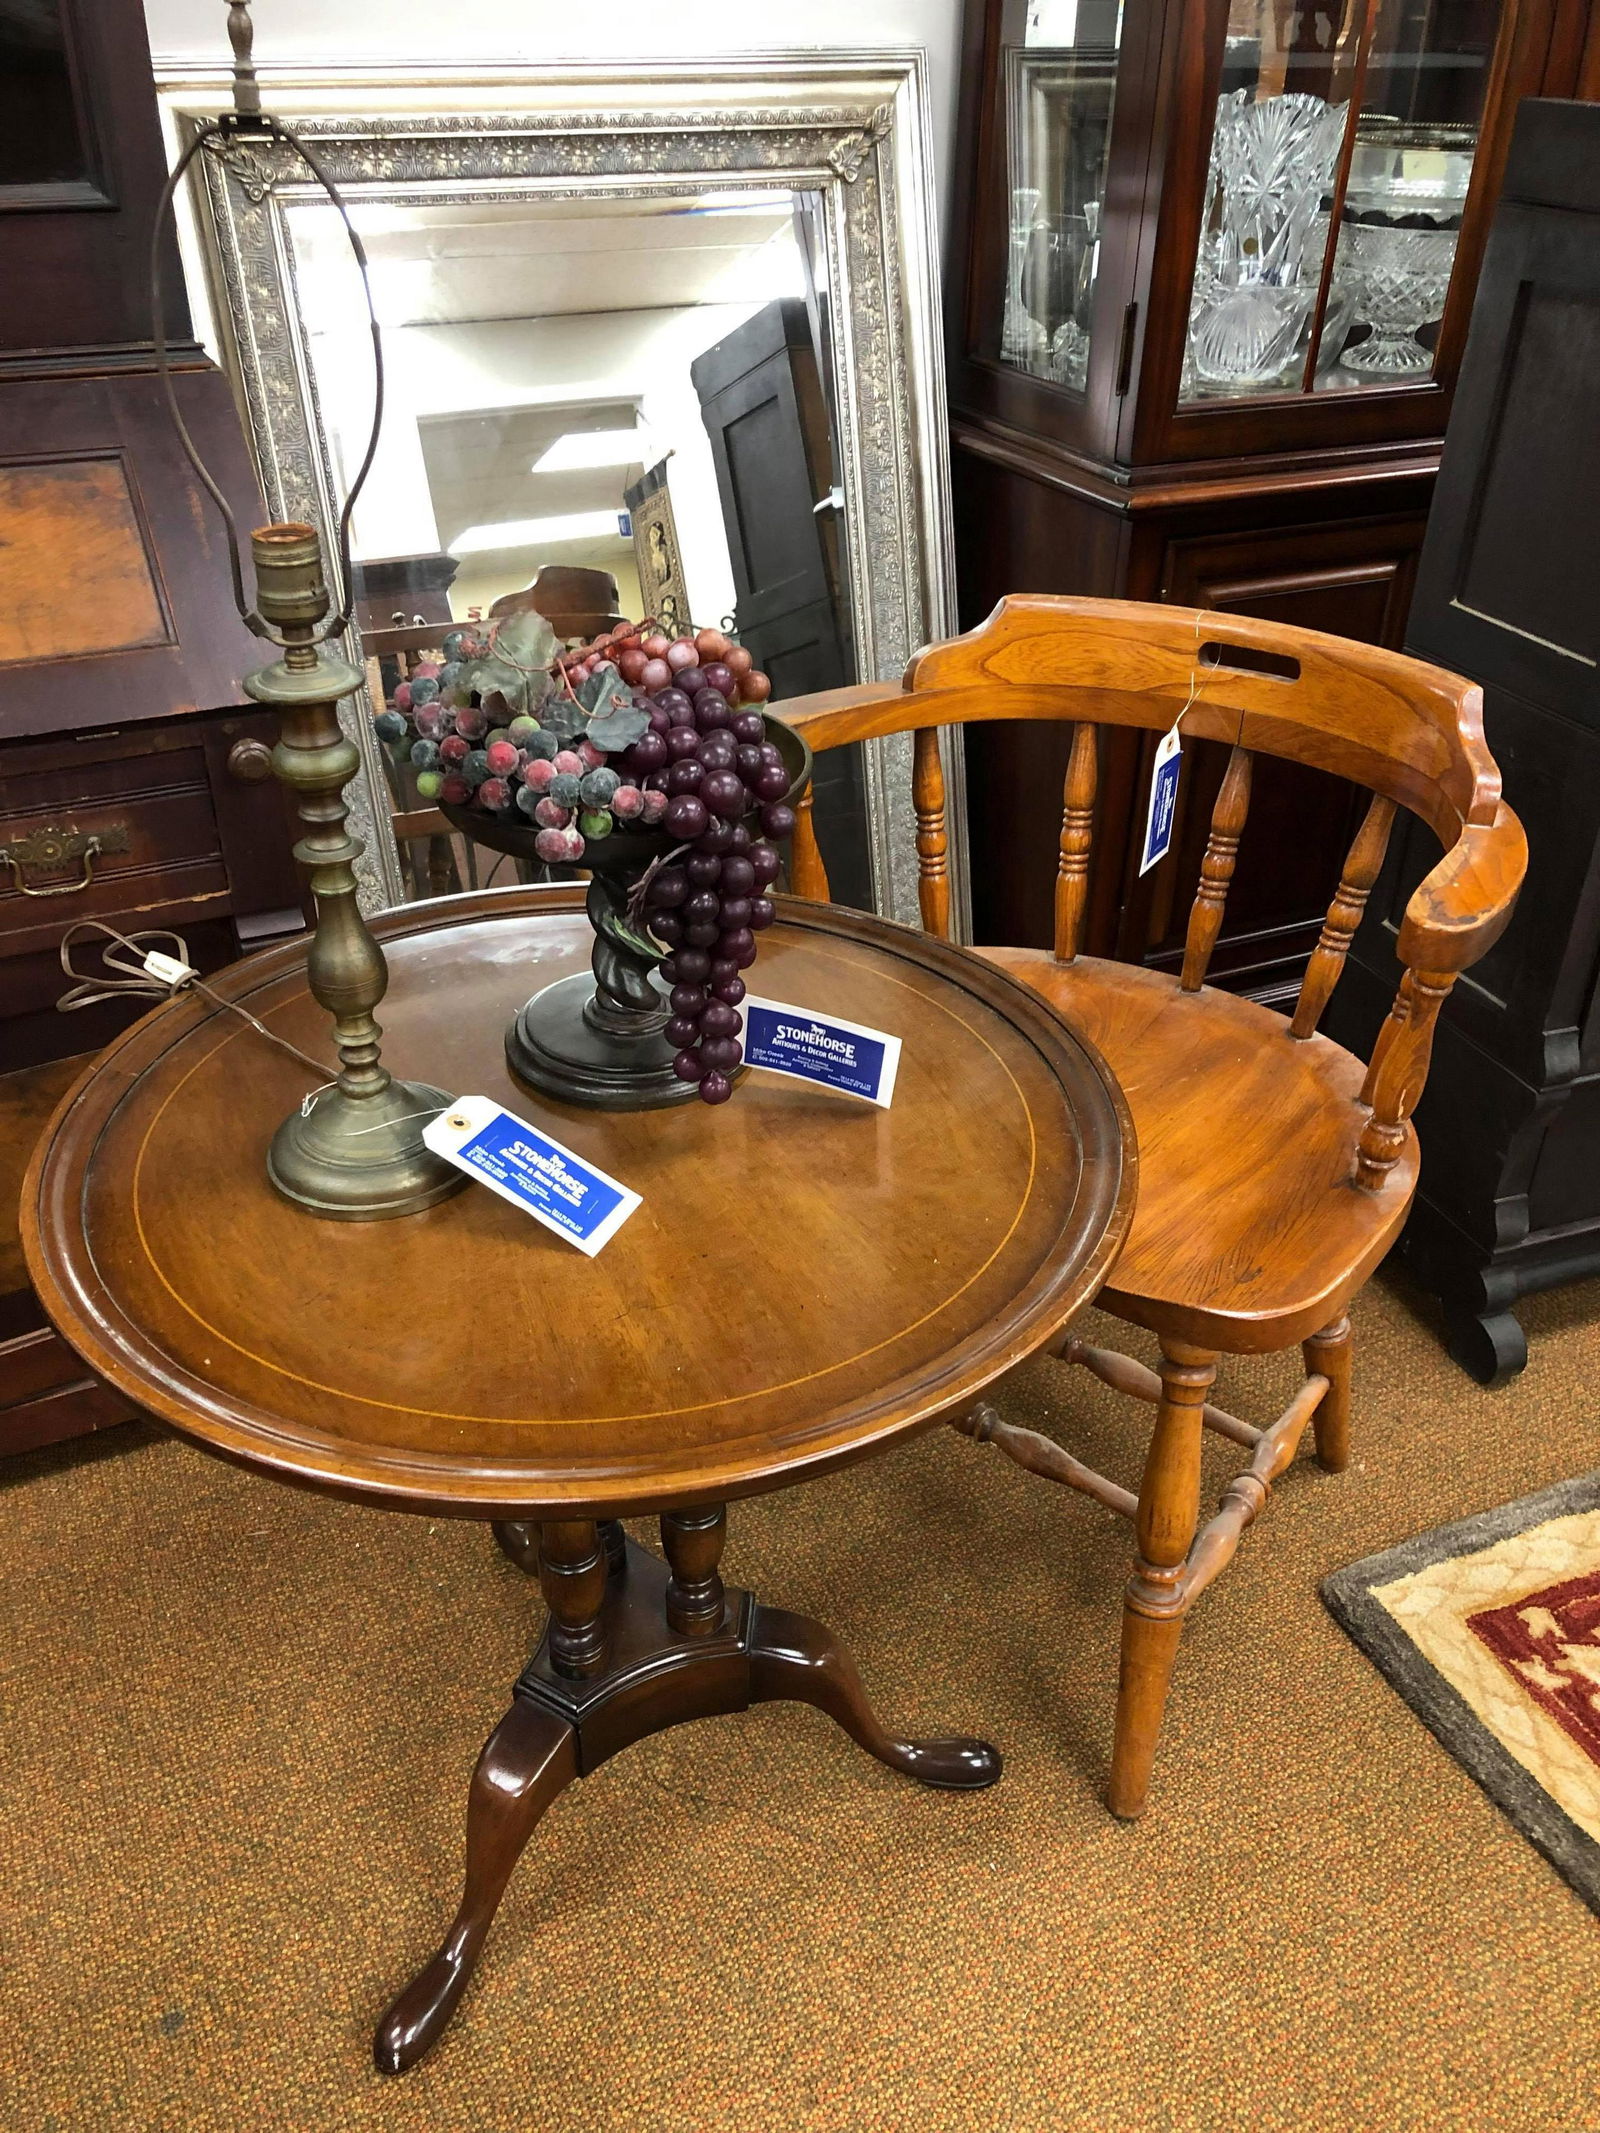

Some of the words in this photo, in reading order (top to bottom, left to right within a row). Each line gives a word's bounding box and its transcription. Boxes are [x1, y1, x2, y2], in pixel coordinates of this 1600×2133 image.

[771, 1037, 801, 1052] ANTIQUES
[807, 1046, 827, 1059] DECOR
[827, 1051, 857, 1068] GALLERIES
[776, 1025, 855, 1059] STONEHORSE
[508, 1141, 589, 1200] STONEHORSE
